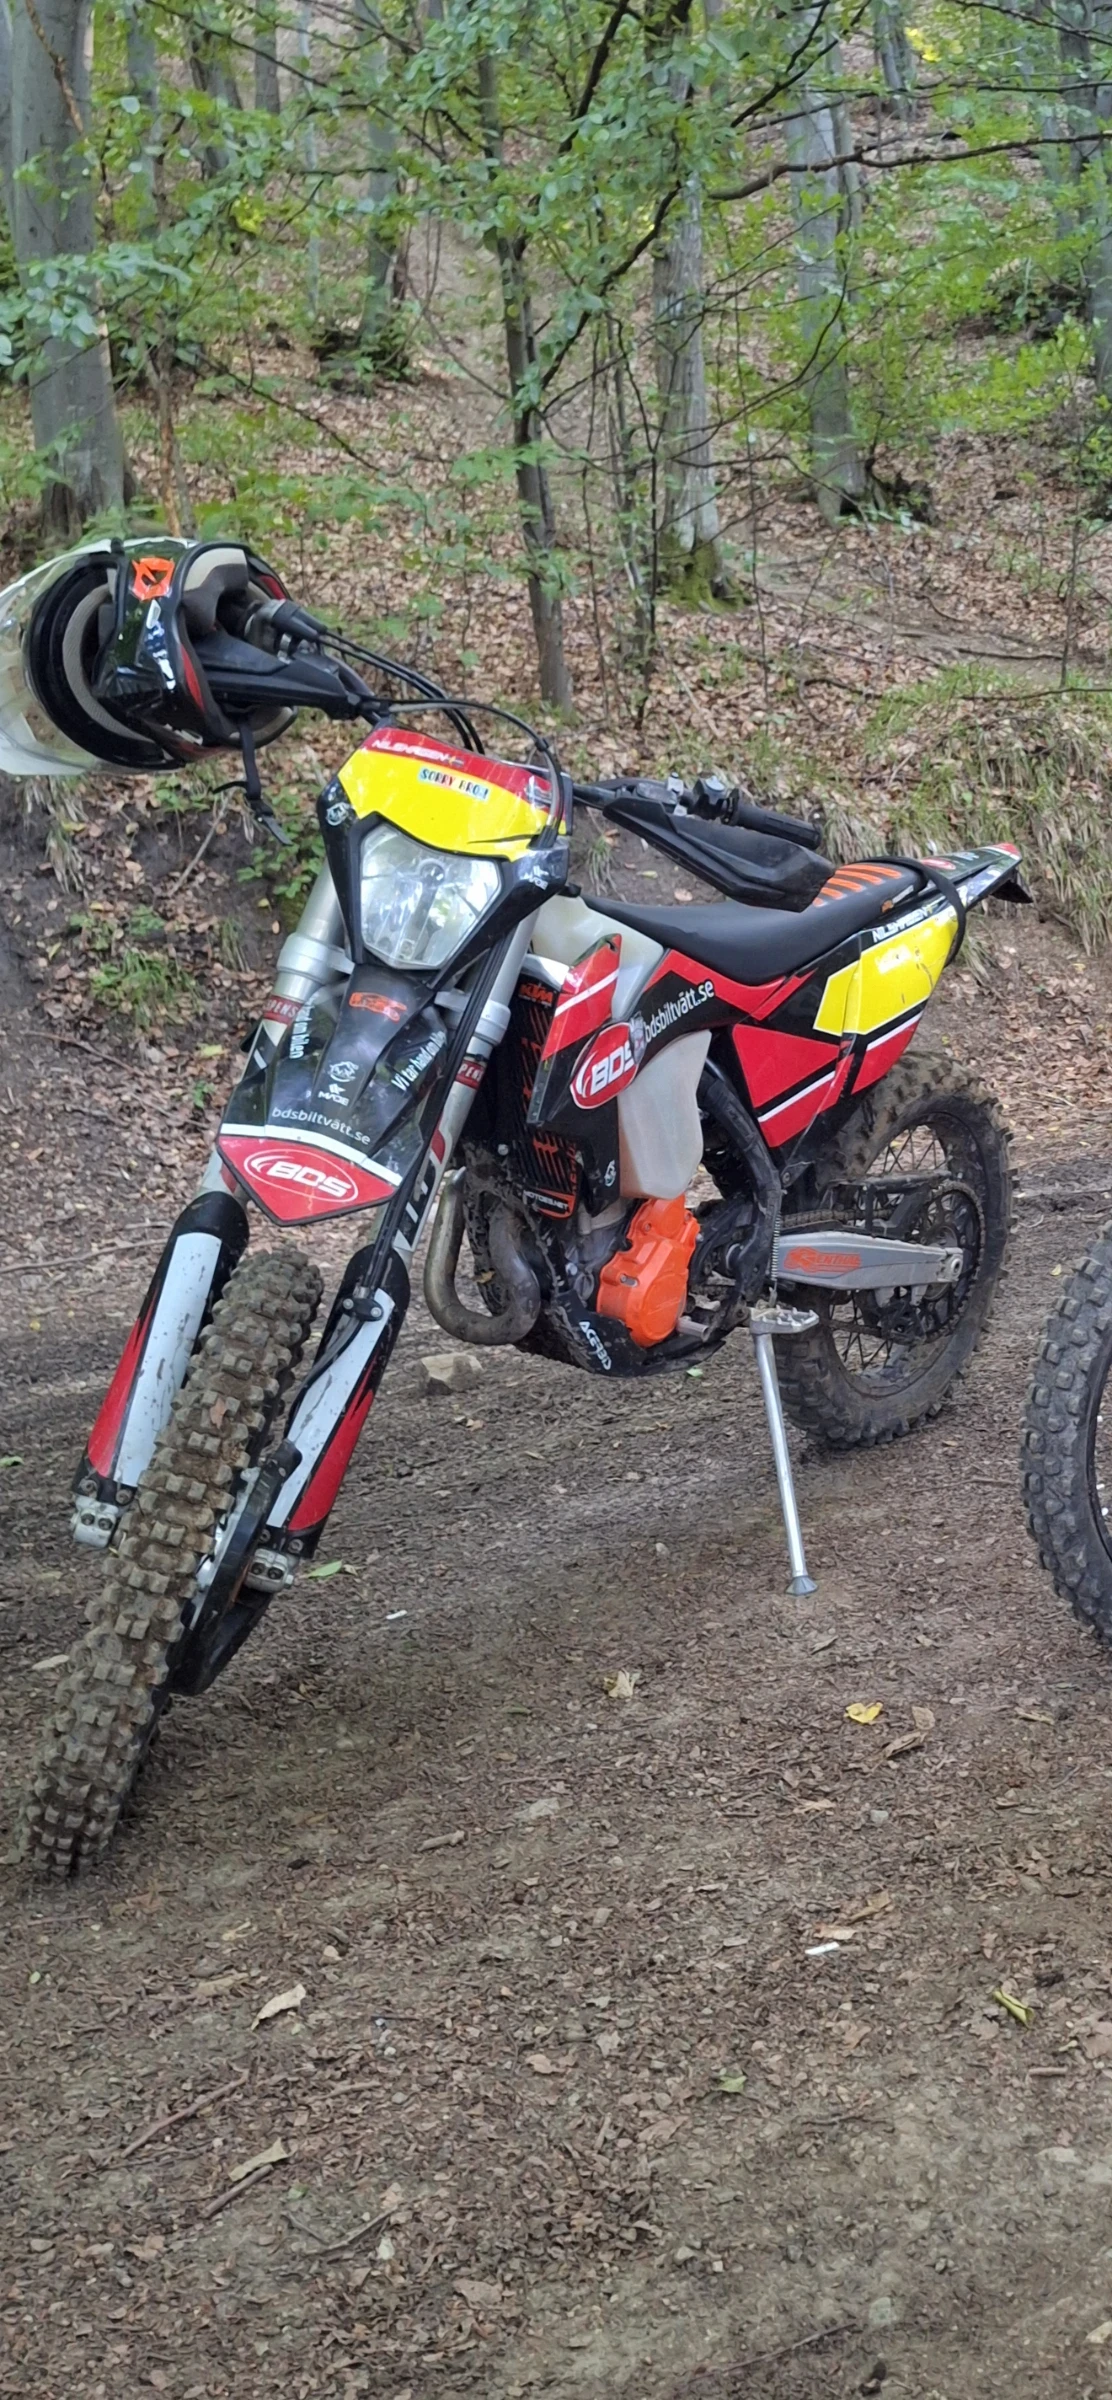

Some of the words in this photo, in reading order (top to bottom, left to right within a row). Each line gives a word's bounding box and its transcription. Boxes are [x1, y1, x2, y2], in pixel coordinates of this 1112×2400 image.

[420, 768, 455, 786] SORRY
[644, 979, 716, 1044] bdsbiltvätt.se
[409, 1046, 433, 1072] hand
[390, 1073, 411, 1092] Vi
[401, 1064, 419, 1082] tar
[271, 1106, 371, 1146] bdsbiltvätt.se
[266, 1160, 352, 1199] BDS
